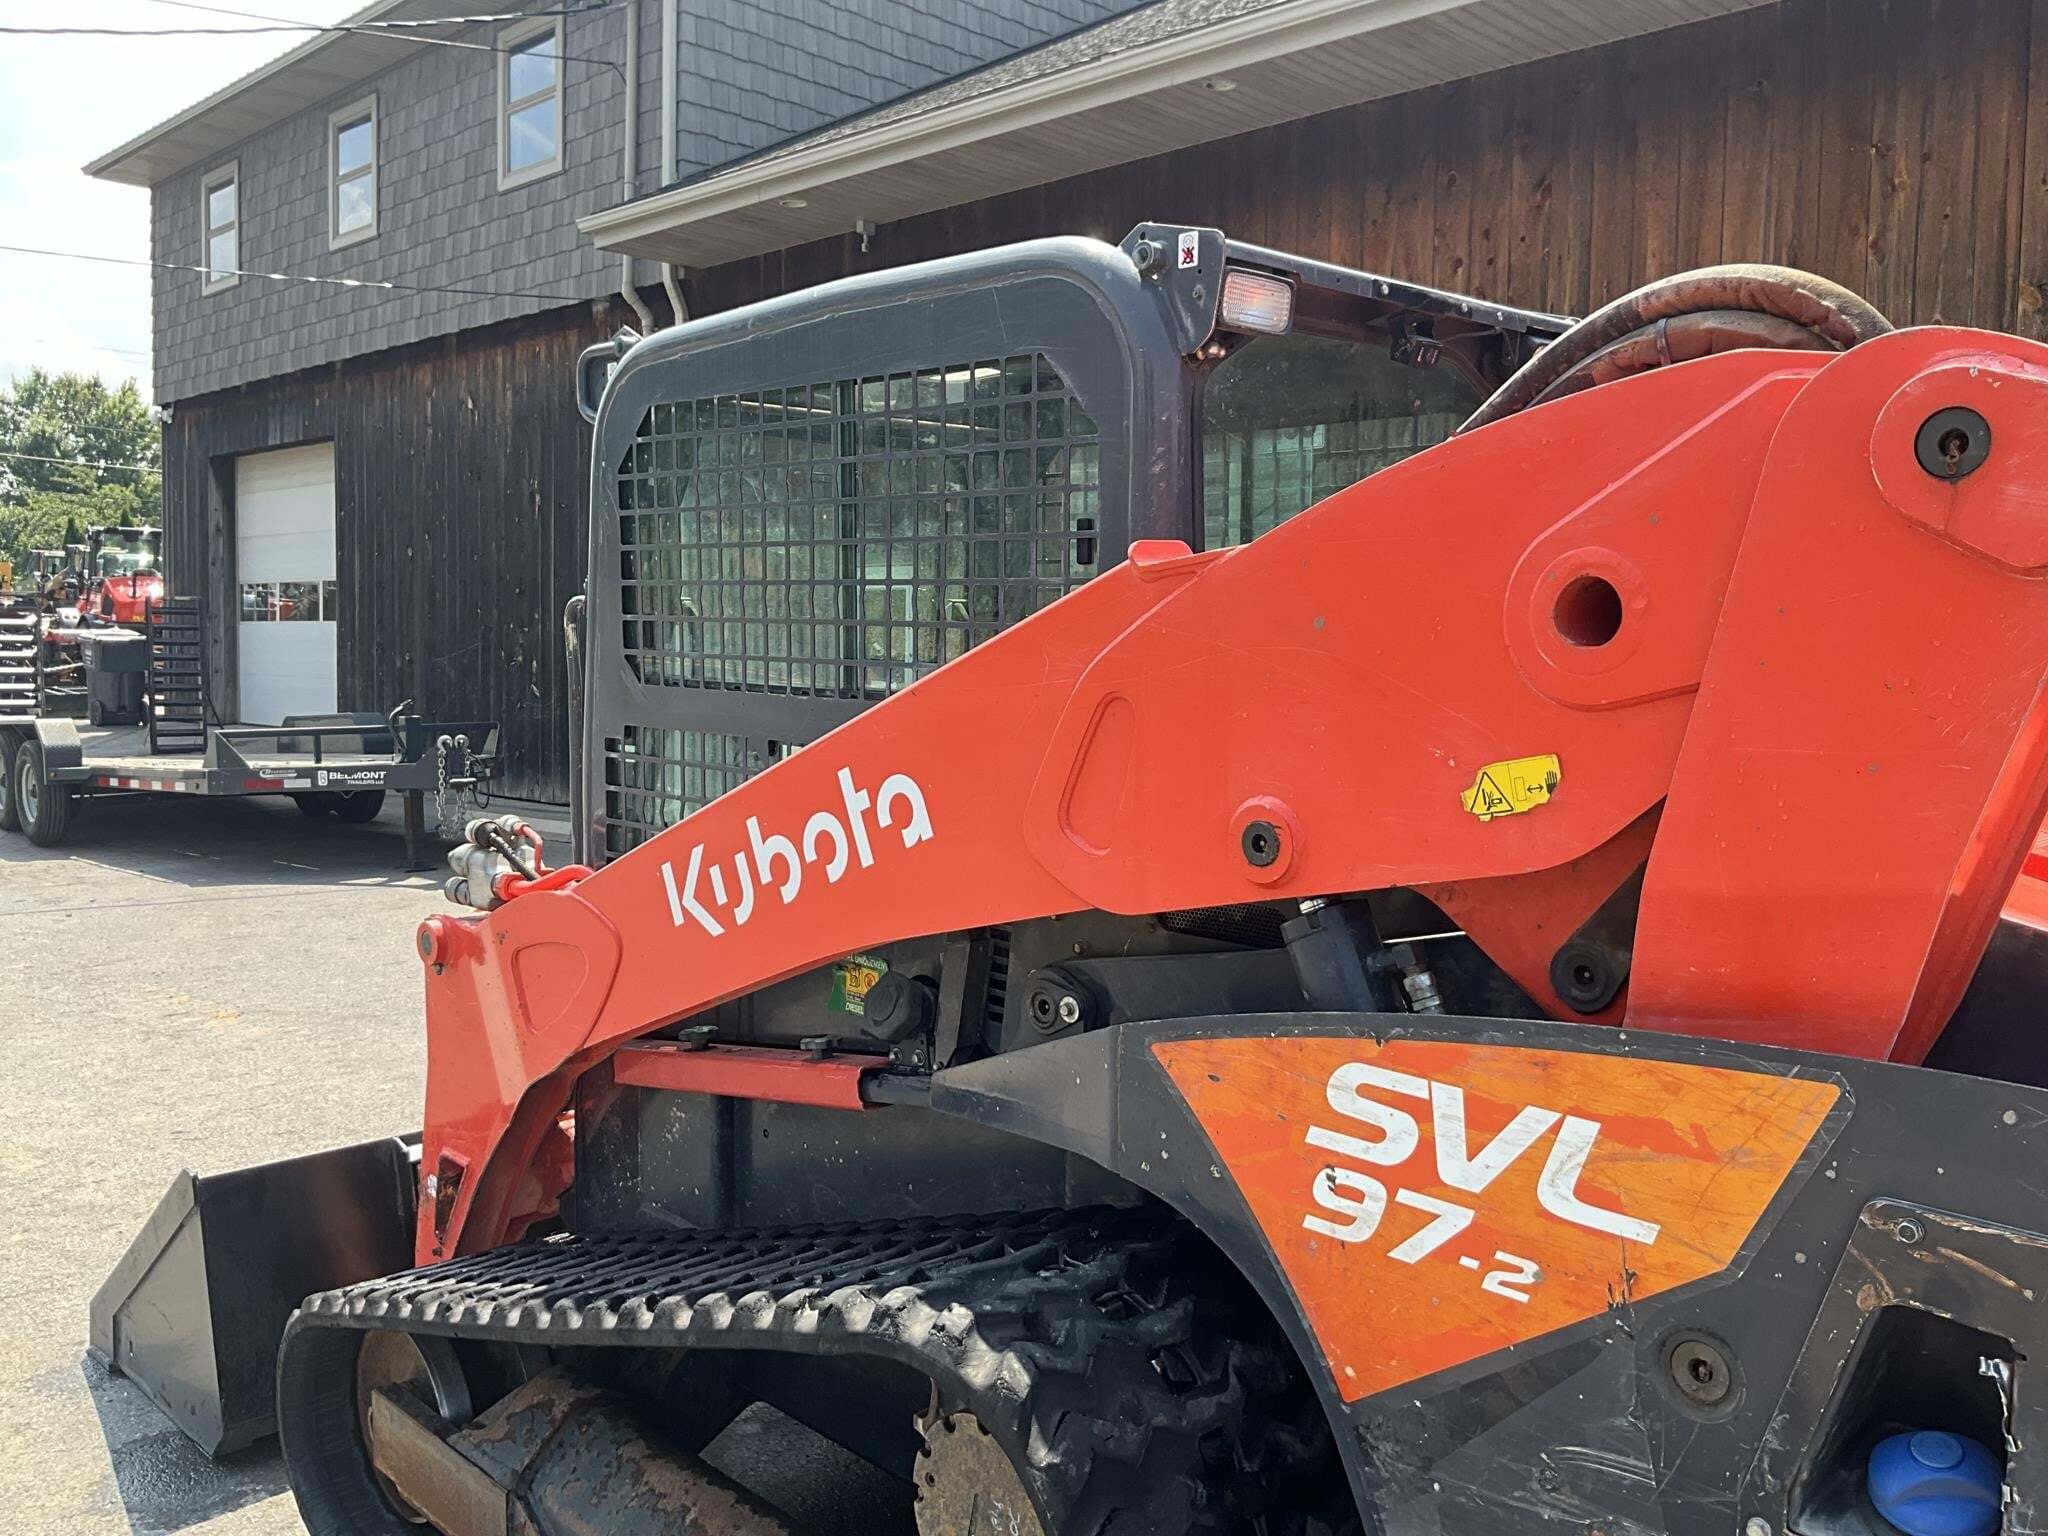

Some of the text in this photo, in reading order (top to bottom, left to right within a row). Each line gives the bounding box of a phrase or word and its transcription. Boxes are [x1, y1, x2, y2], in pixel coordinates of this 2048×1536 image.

[328, 771, 387, 780] BELMONT
[660, 766, 934, 937] Kubota
[1305, 1062, 1661, 1245] SVL
[1302, 1167, 1541, 1303] 97-2
